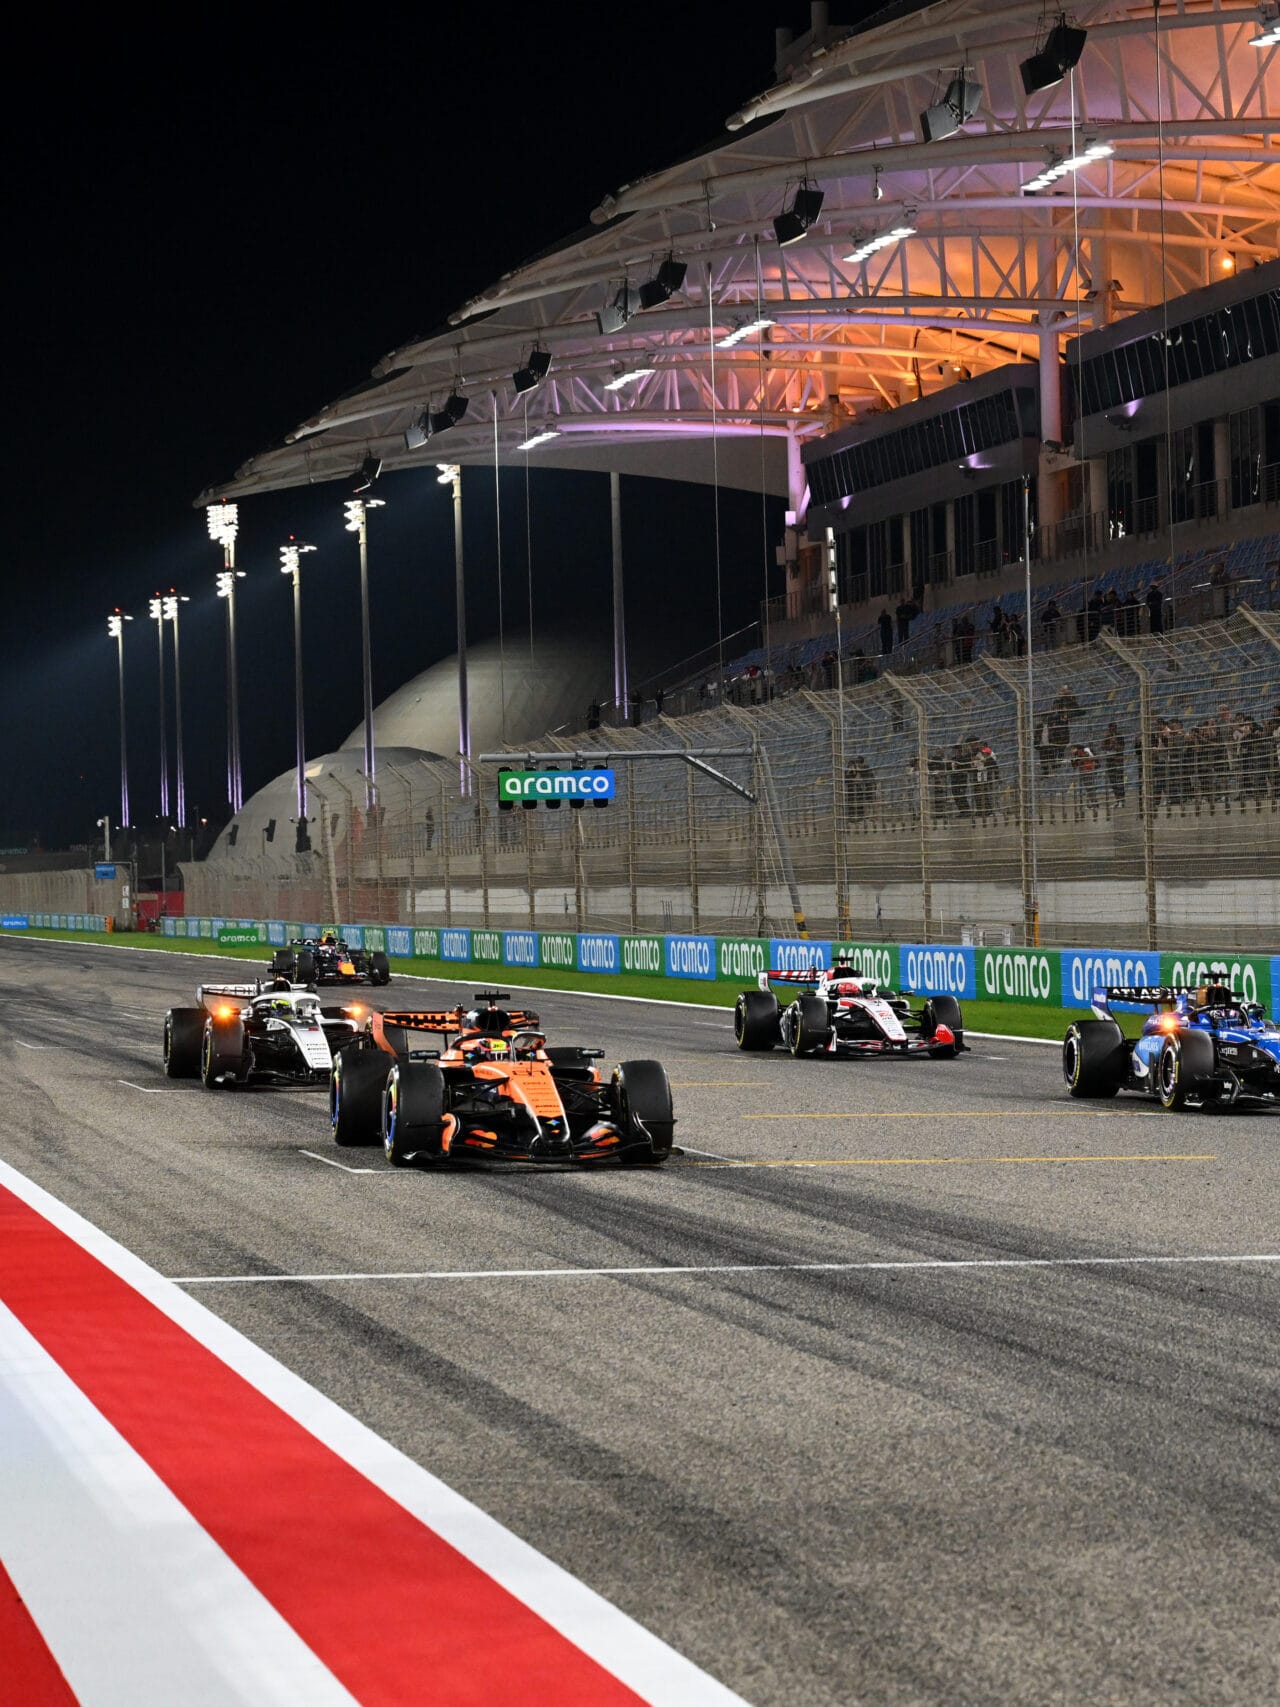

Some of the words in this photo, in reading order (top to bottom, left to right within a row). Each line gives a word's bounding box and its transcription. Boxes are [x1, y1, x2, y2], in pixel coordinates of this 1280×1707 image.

[505, 776, 609, 794] aramco
[220, 934, 257, 942] aramco
[473, 933, 499, 960] aramco
[506, 935, 534, 963] aramco
[542, 936, 573, 965] aramco
[581, 938, 615, 969] aramco
[624, 940, 660, 971] aramco
[670, 941, 709, 974] aramco
[721, 942, 764, 977] aramco
[907, 951, 966, 992] aramco
[984, 953, 1050, 999] aramco
